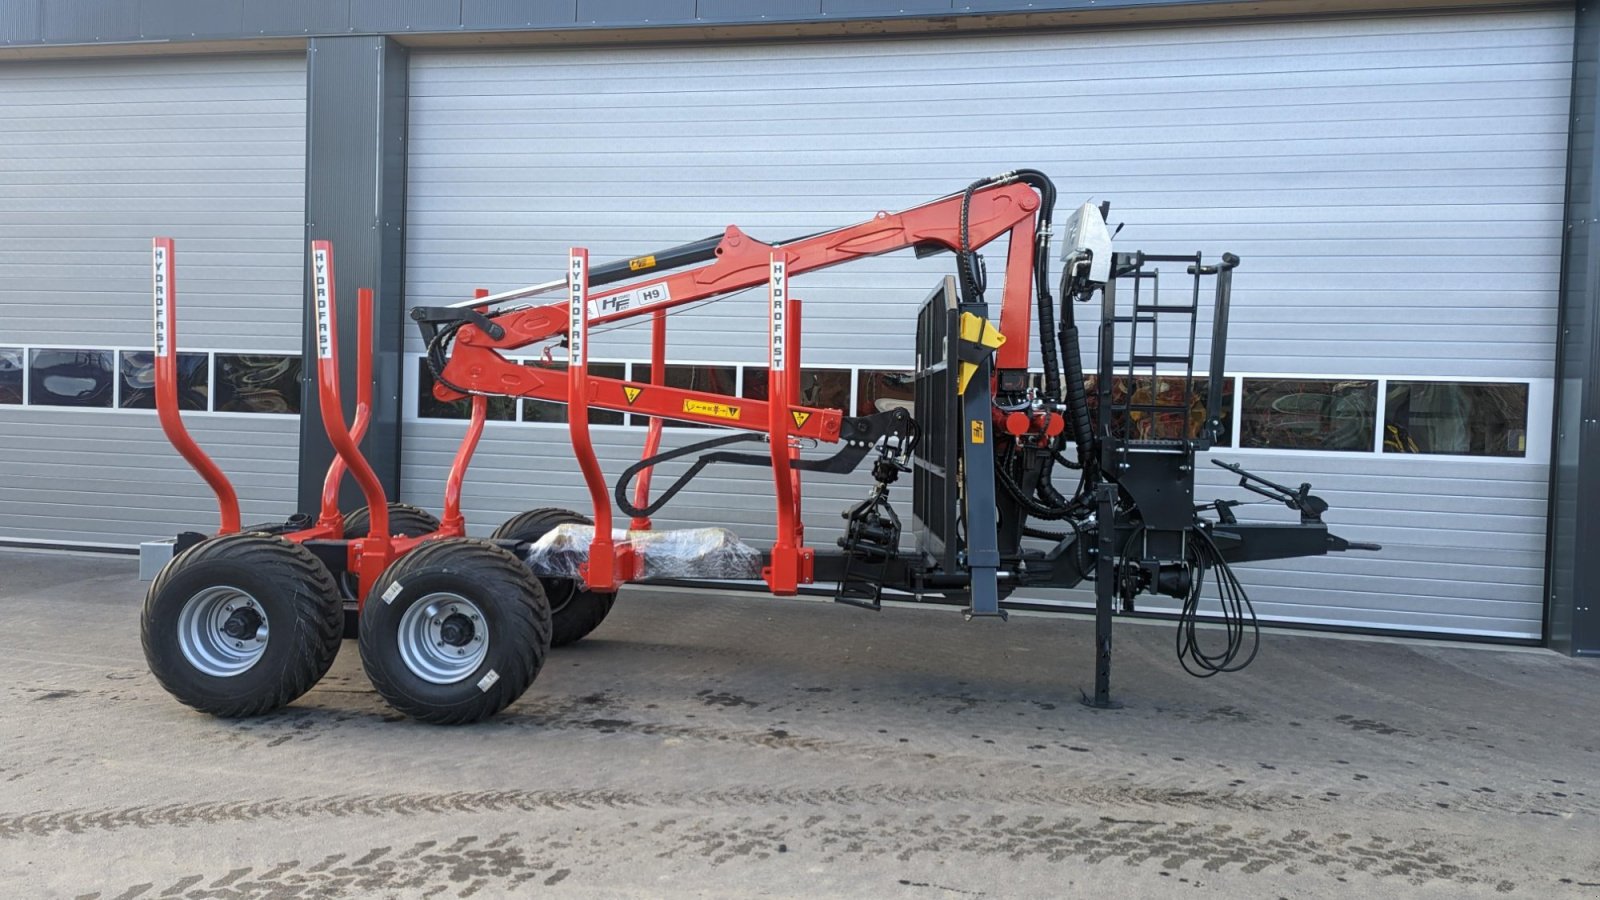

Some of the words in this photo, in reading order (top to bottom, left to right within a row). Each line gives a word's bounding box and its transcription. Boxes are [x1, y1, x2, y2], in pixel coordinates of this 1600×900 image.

[155, 250, 163, 353] HYDROFAST
[315, 253, 328, 355] HYDROFAST
[572, 260, 581, 363] HYDROFAST
[643, 289, 660, 301] H9
[773, 265, 782, 366] HYDROFAST
